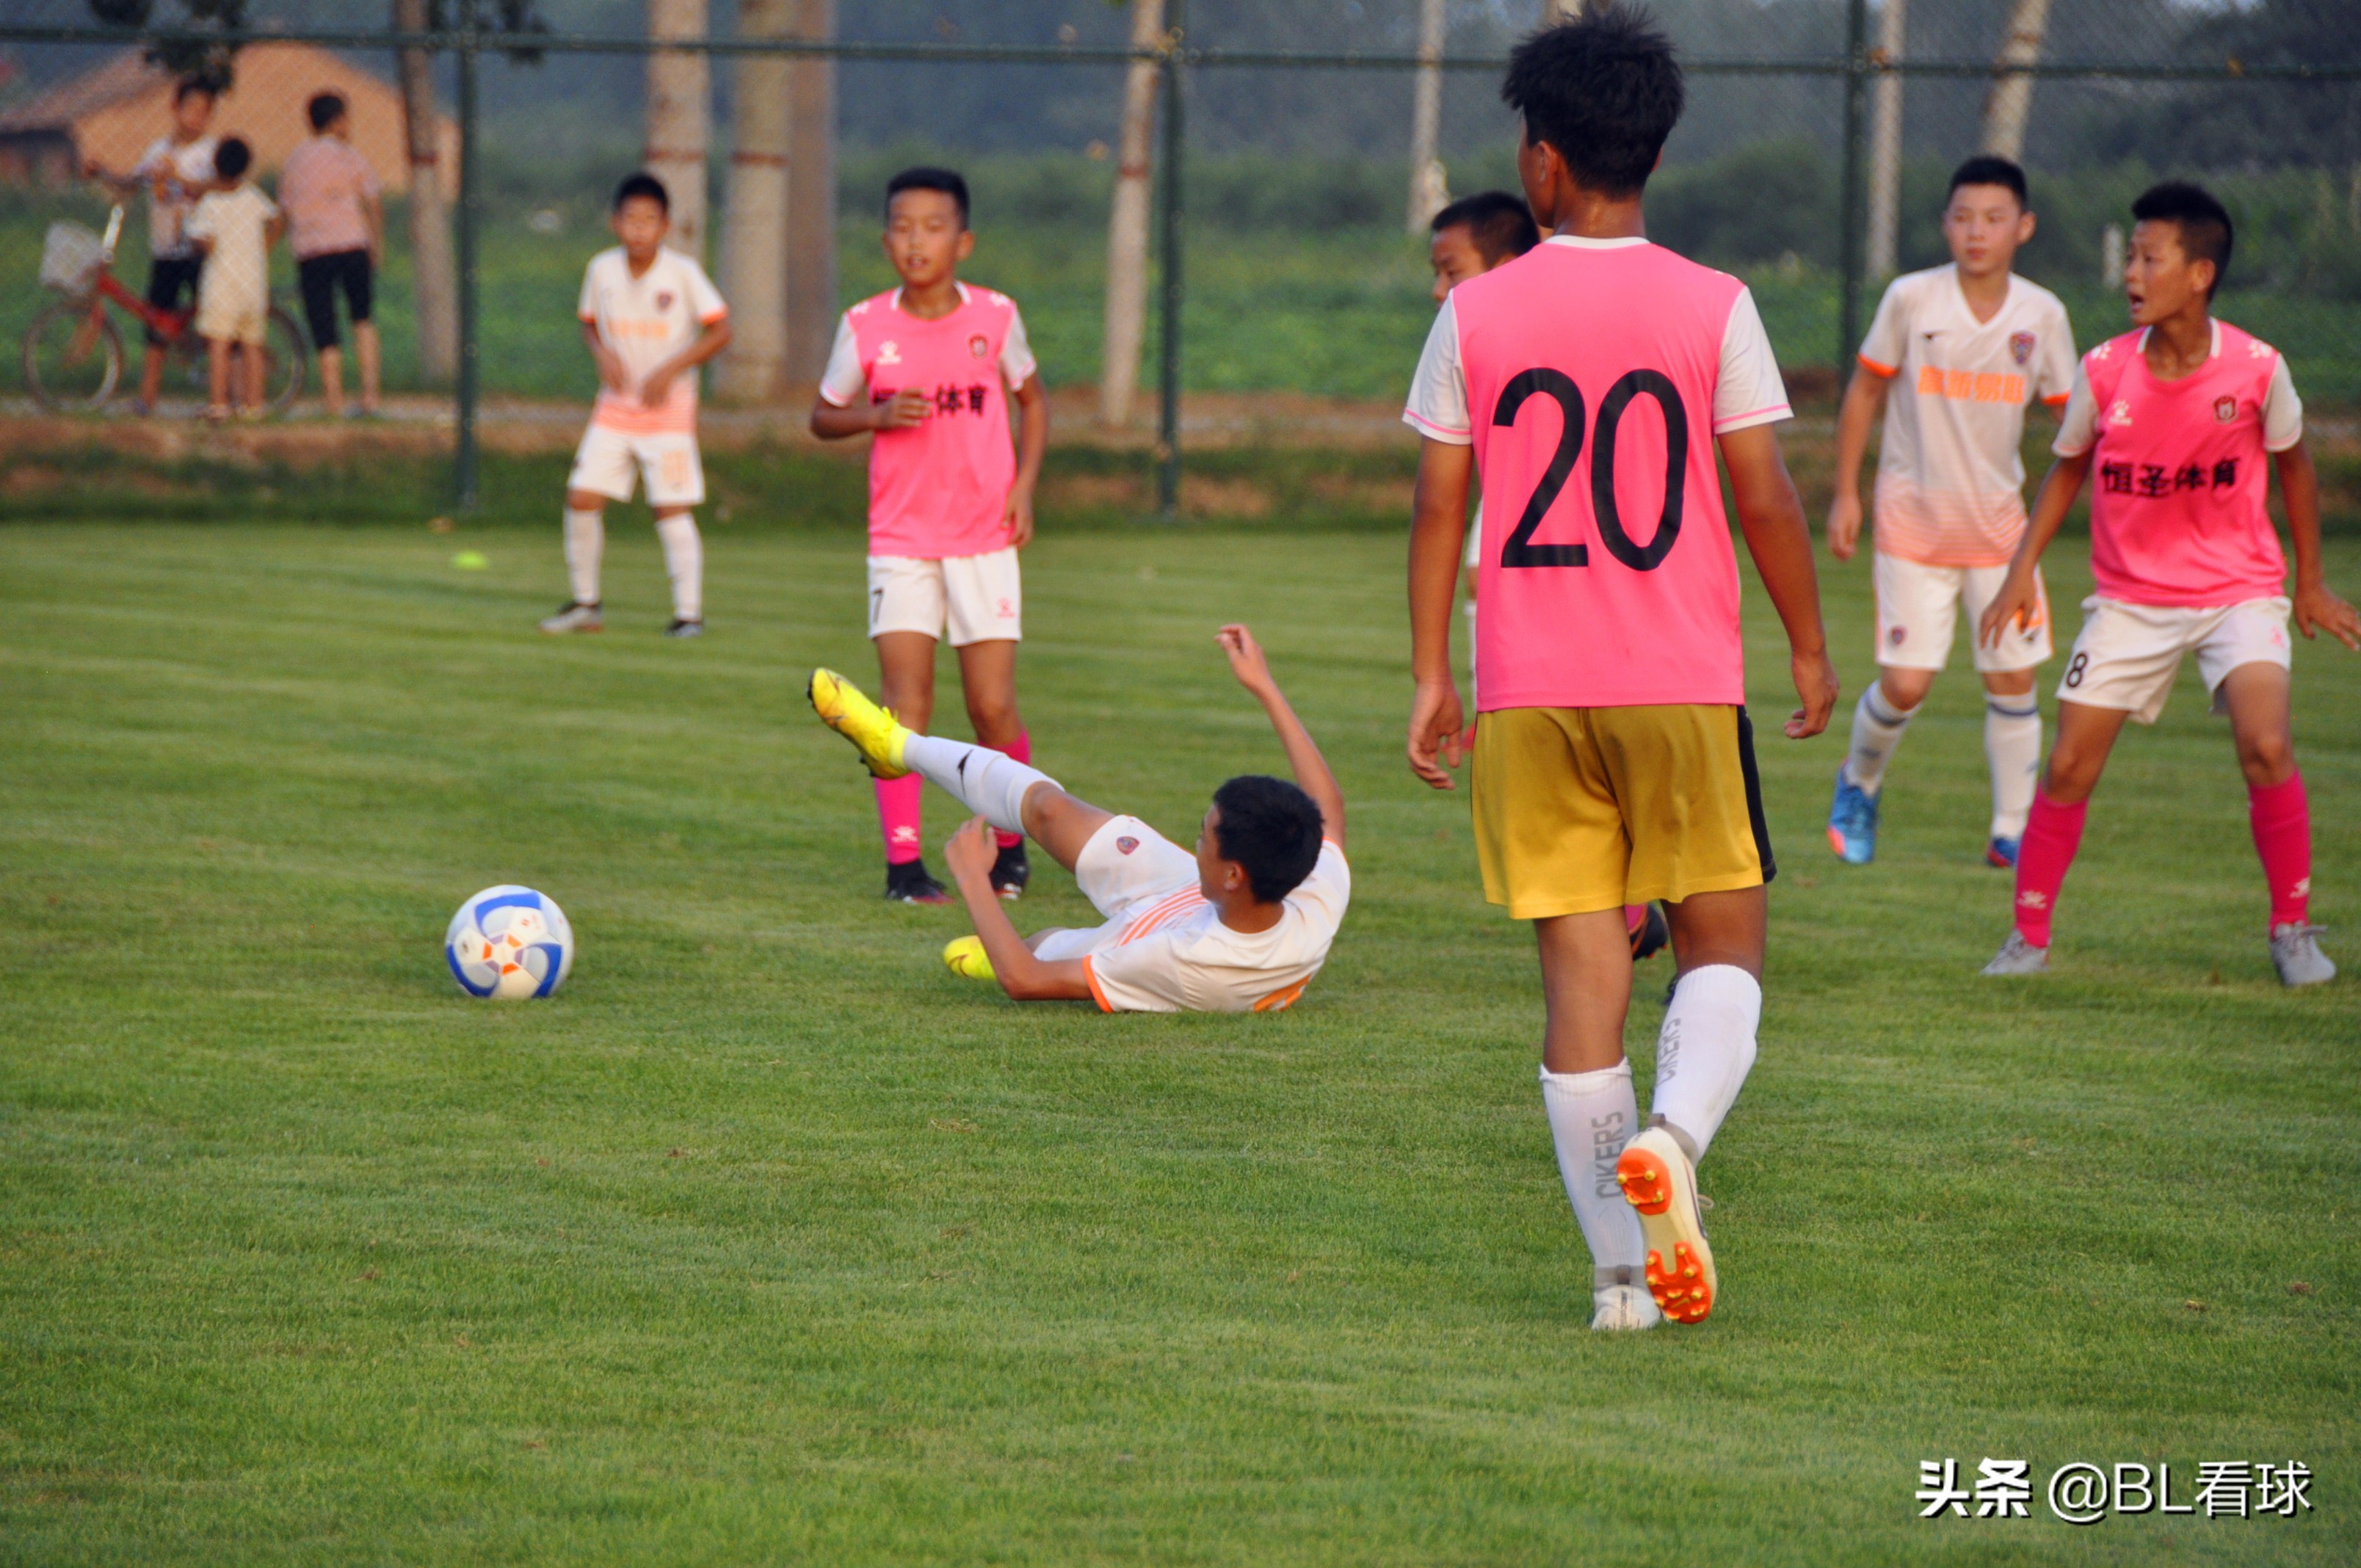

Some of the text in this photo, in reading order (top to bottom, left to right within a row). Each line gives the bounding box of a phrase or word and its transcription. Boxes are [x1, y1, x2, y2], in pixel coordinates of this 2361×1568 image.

[1493, 367, 1688, 572] 20
[2102, 457, 2240, 497] 恒圣体育
[871, 587, 885, 625] 7
[2066, 653, 2089, 688] 8
